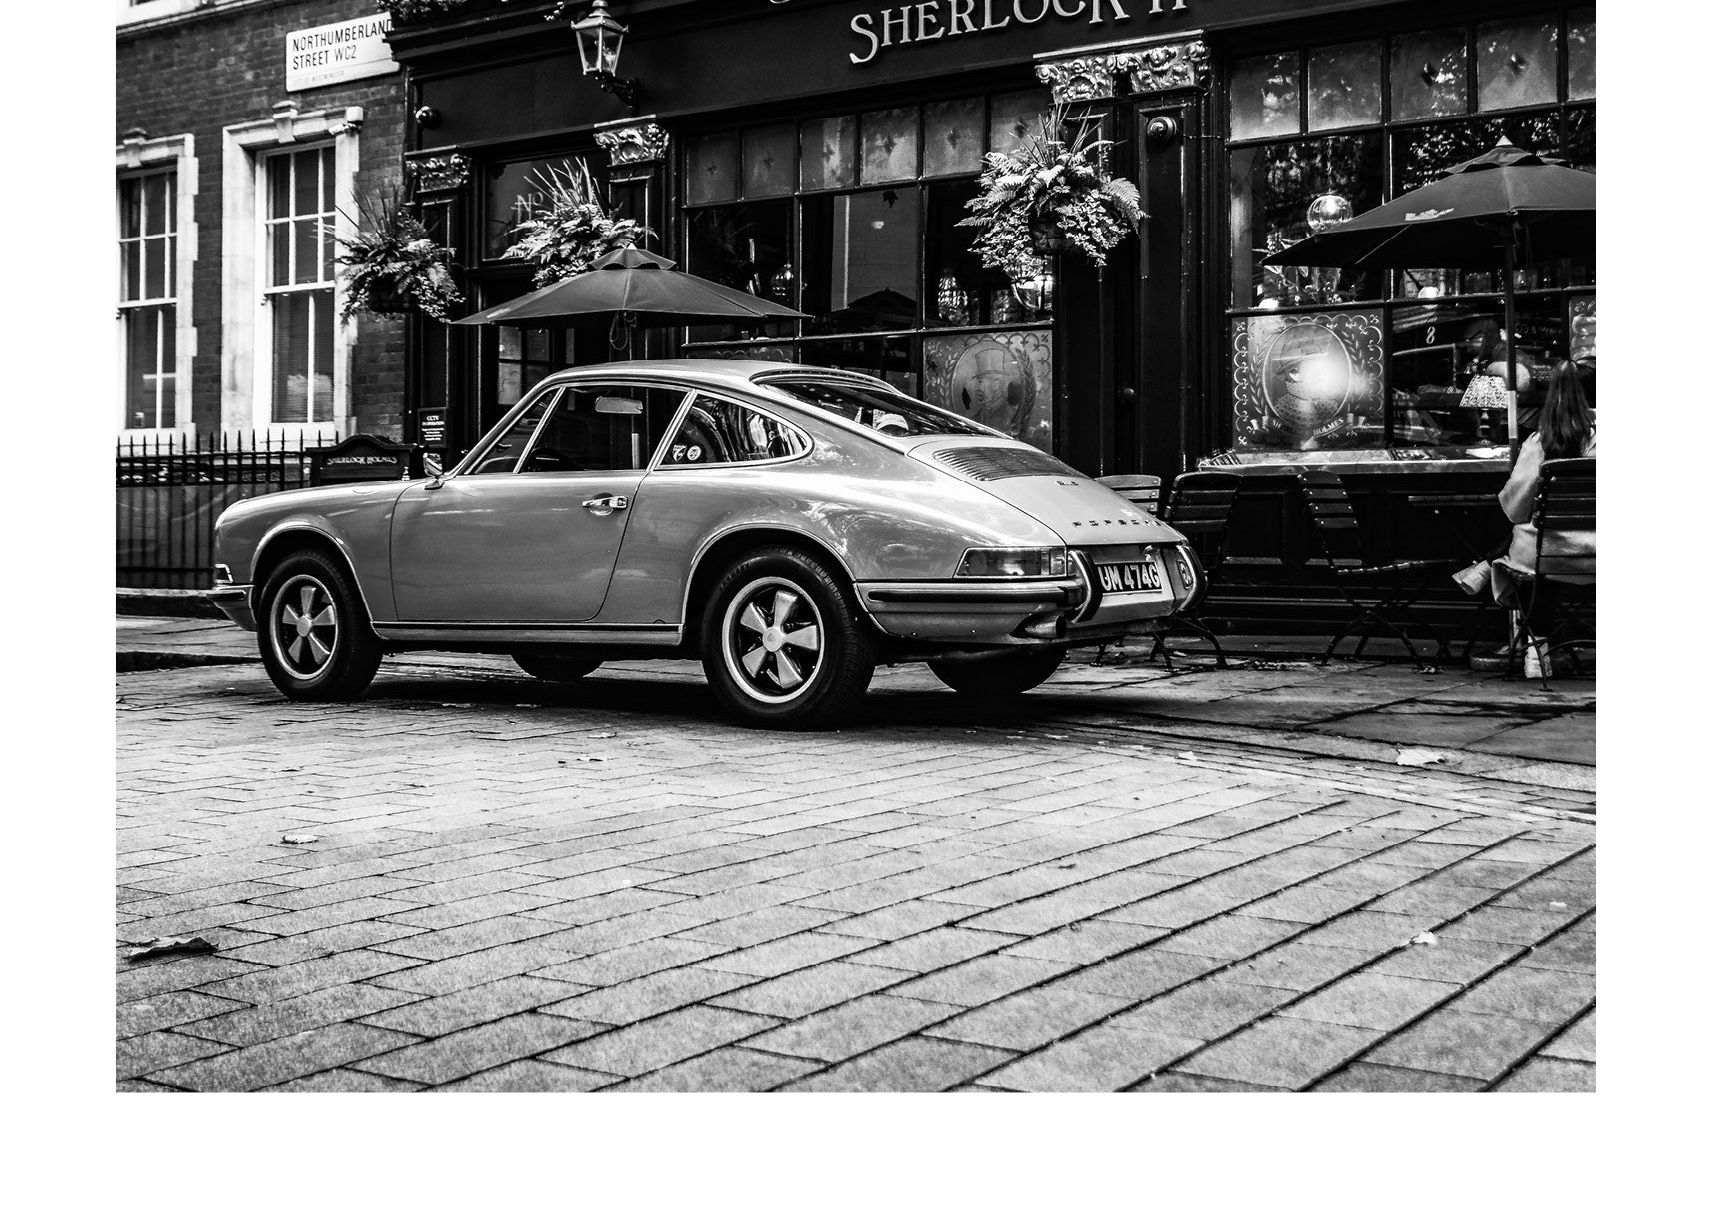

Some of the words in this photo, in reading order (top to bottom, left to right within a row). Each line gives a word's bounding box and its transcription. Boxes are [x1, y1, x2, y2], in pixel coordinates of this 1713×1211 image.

[293, 50, 329, 70] STREET
[334, 45, 357, 62] WC2
[1425, 325, 1436, 345] 8
[1313, 417, 1344, 436] HOLMES
[1123, 564, 1161, 590] 474G
